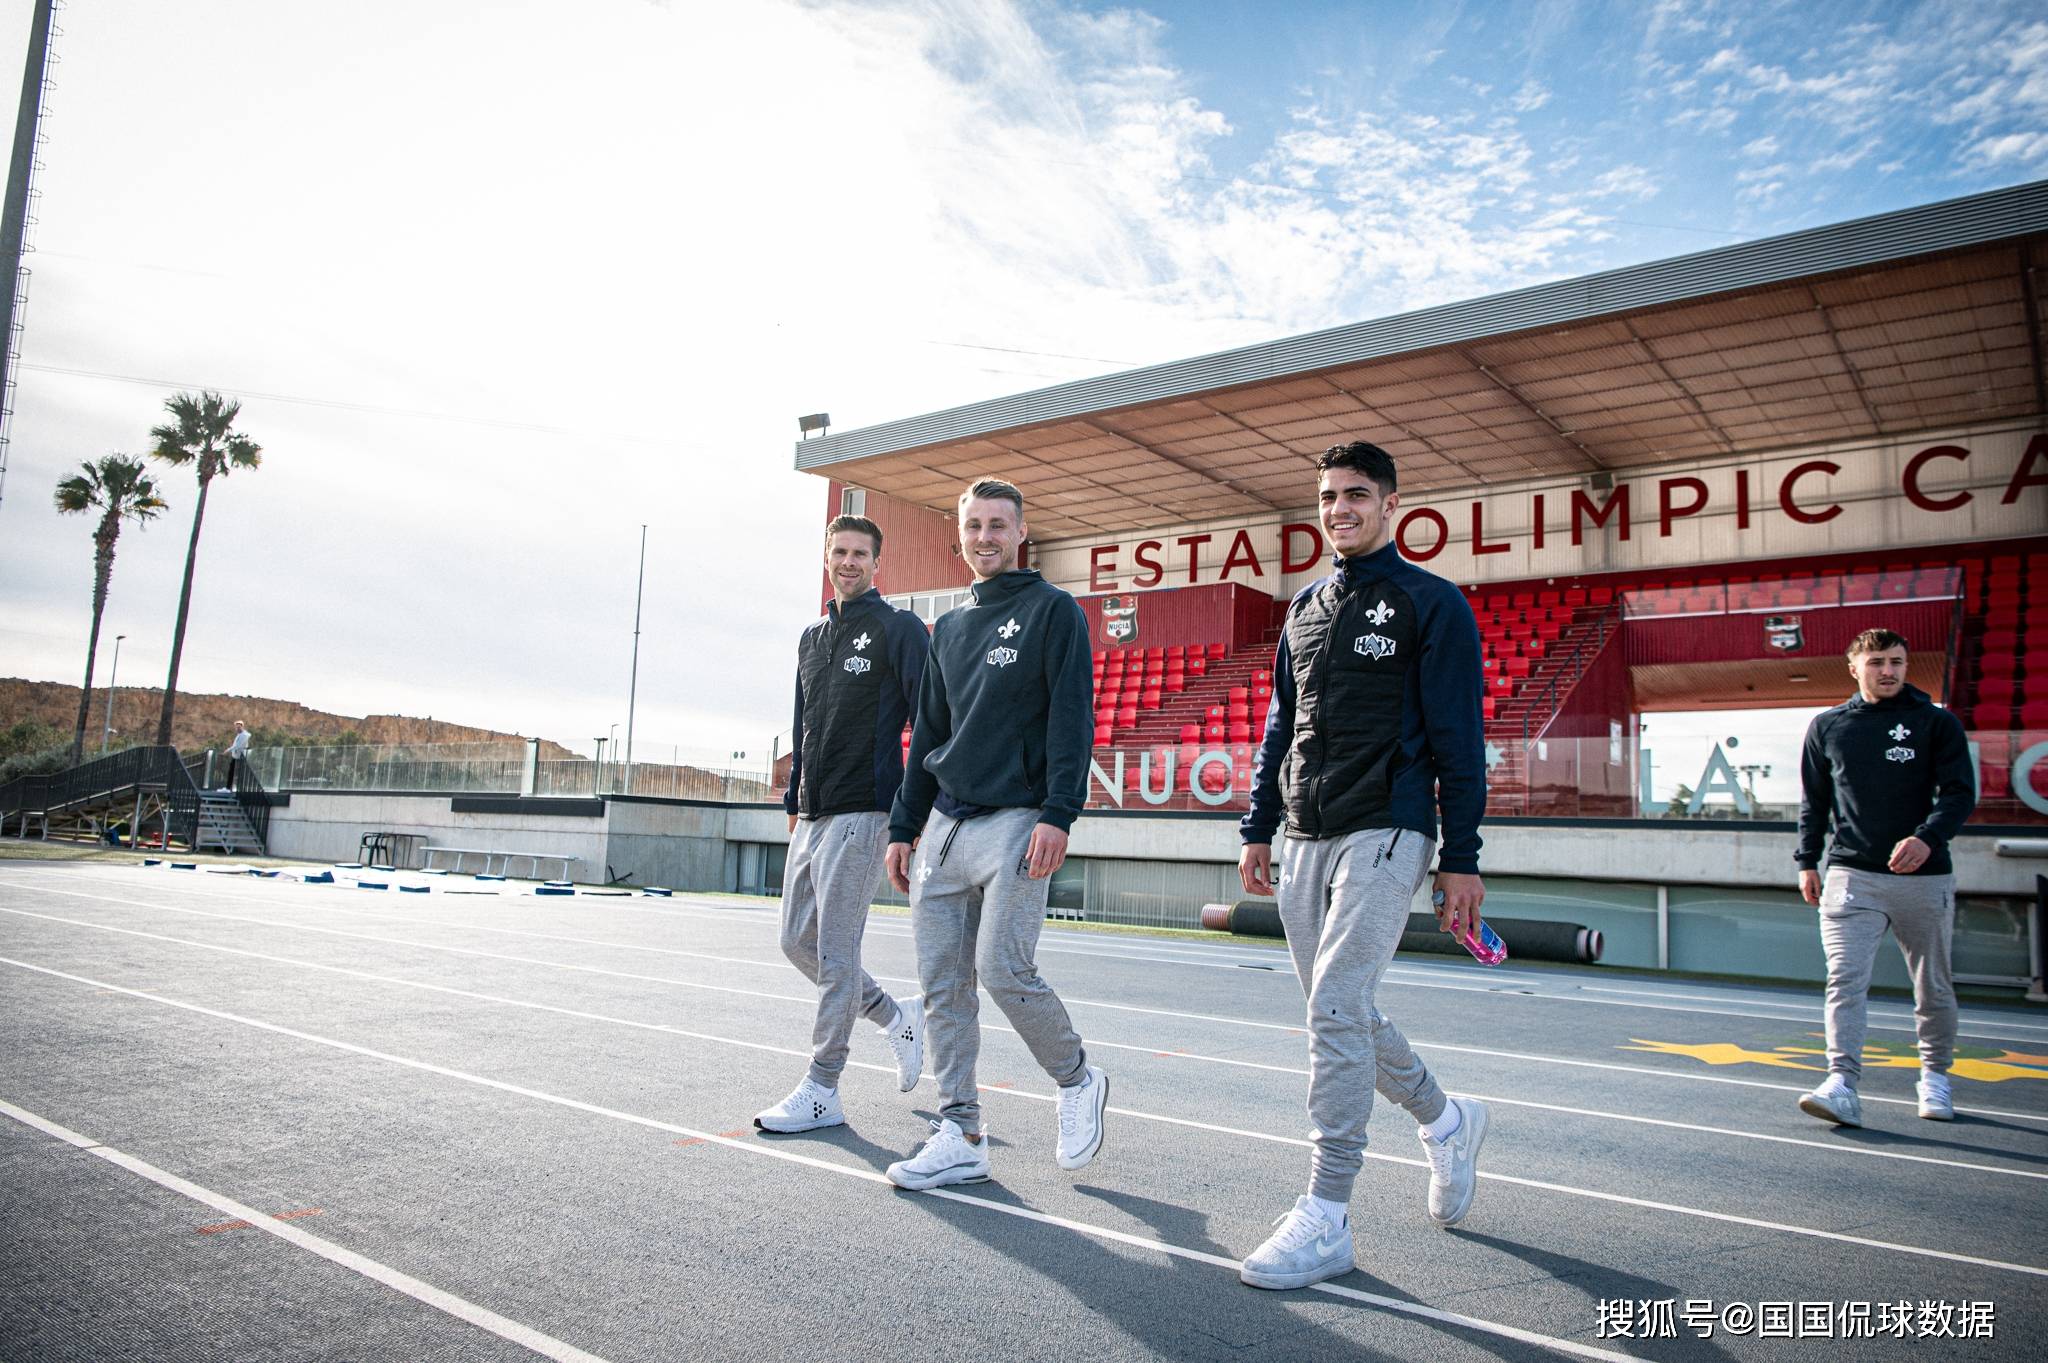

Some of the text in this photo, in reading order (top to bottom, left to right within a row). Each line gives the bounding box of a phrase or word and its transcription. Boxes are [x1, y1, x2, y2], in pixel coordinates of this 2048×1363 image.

[1090, 523, 1323, 592] ESTAD
[1396, 461, 1844, 562] OLIMPIC
[1108, 622, 1130, 631] NUCIA
[1086, 750, 1262, 808] NUC
